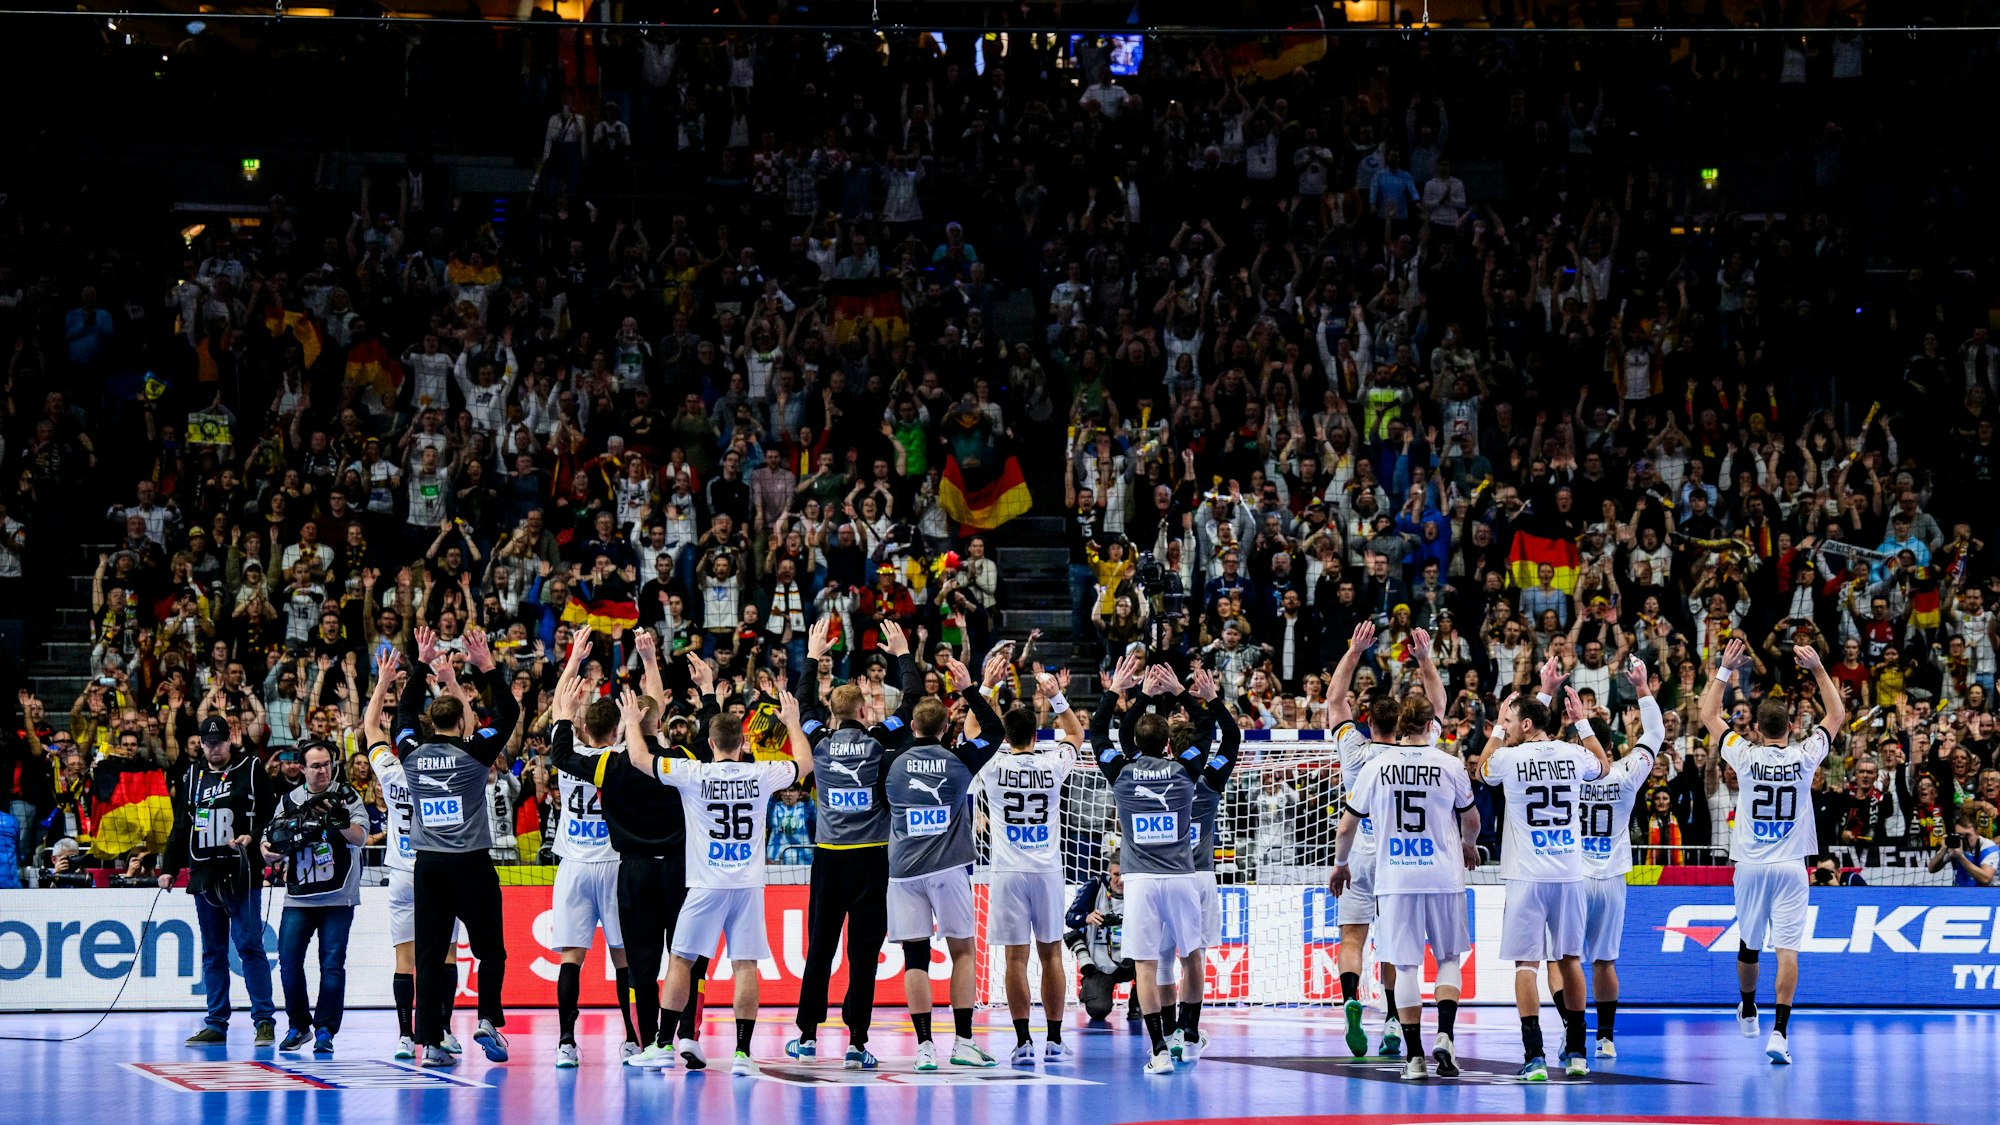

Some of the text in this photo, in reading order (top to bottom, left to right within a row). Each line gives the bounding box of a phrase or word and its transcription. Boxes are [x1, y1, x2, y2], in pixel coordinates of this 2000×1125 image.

[830, 742, 866, 756] GERMANY
[417, 756, 457, 771] GERMANY
[906, 759, 947, 773] GERMANY
[1132, 766, 1172, 780] GERMANY
[1516, 759, 1577, 782] HÄFNER
[1751, 762, 1803, 782] WEBER
[997, 768, 1054, 788] USCINS
[1380, 764, 1441, 786] KNORR
[700, 779, 760, 800] MERTENS
[831, 791, 869, 807] DKB
[423, 800, 459, 816] DKB
[1003, 791, 1049, 825] 23
[1394, 790, 1427, 833] 15
[1525, 785, 1572, 826] 25
[1752, 785, 1797, 821] 20
[706, 803, 754, 840] 36
[910, 809, 947, 825] DKB
[1135, 816, 1174, 833] DKB
[568, 819, 609, 838] DKB
[1006, 825, 1049, 843] DKB
[1389, 837, 1434, 857] DKB
[1530, 829, 1575, 848] DKB
[1582, 837, 1612, 852] KB
[708, 841, 752, 861] DKB
